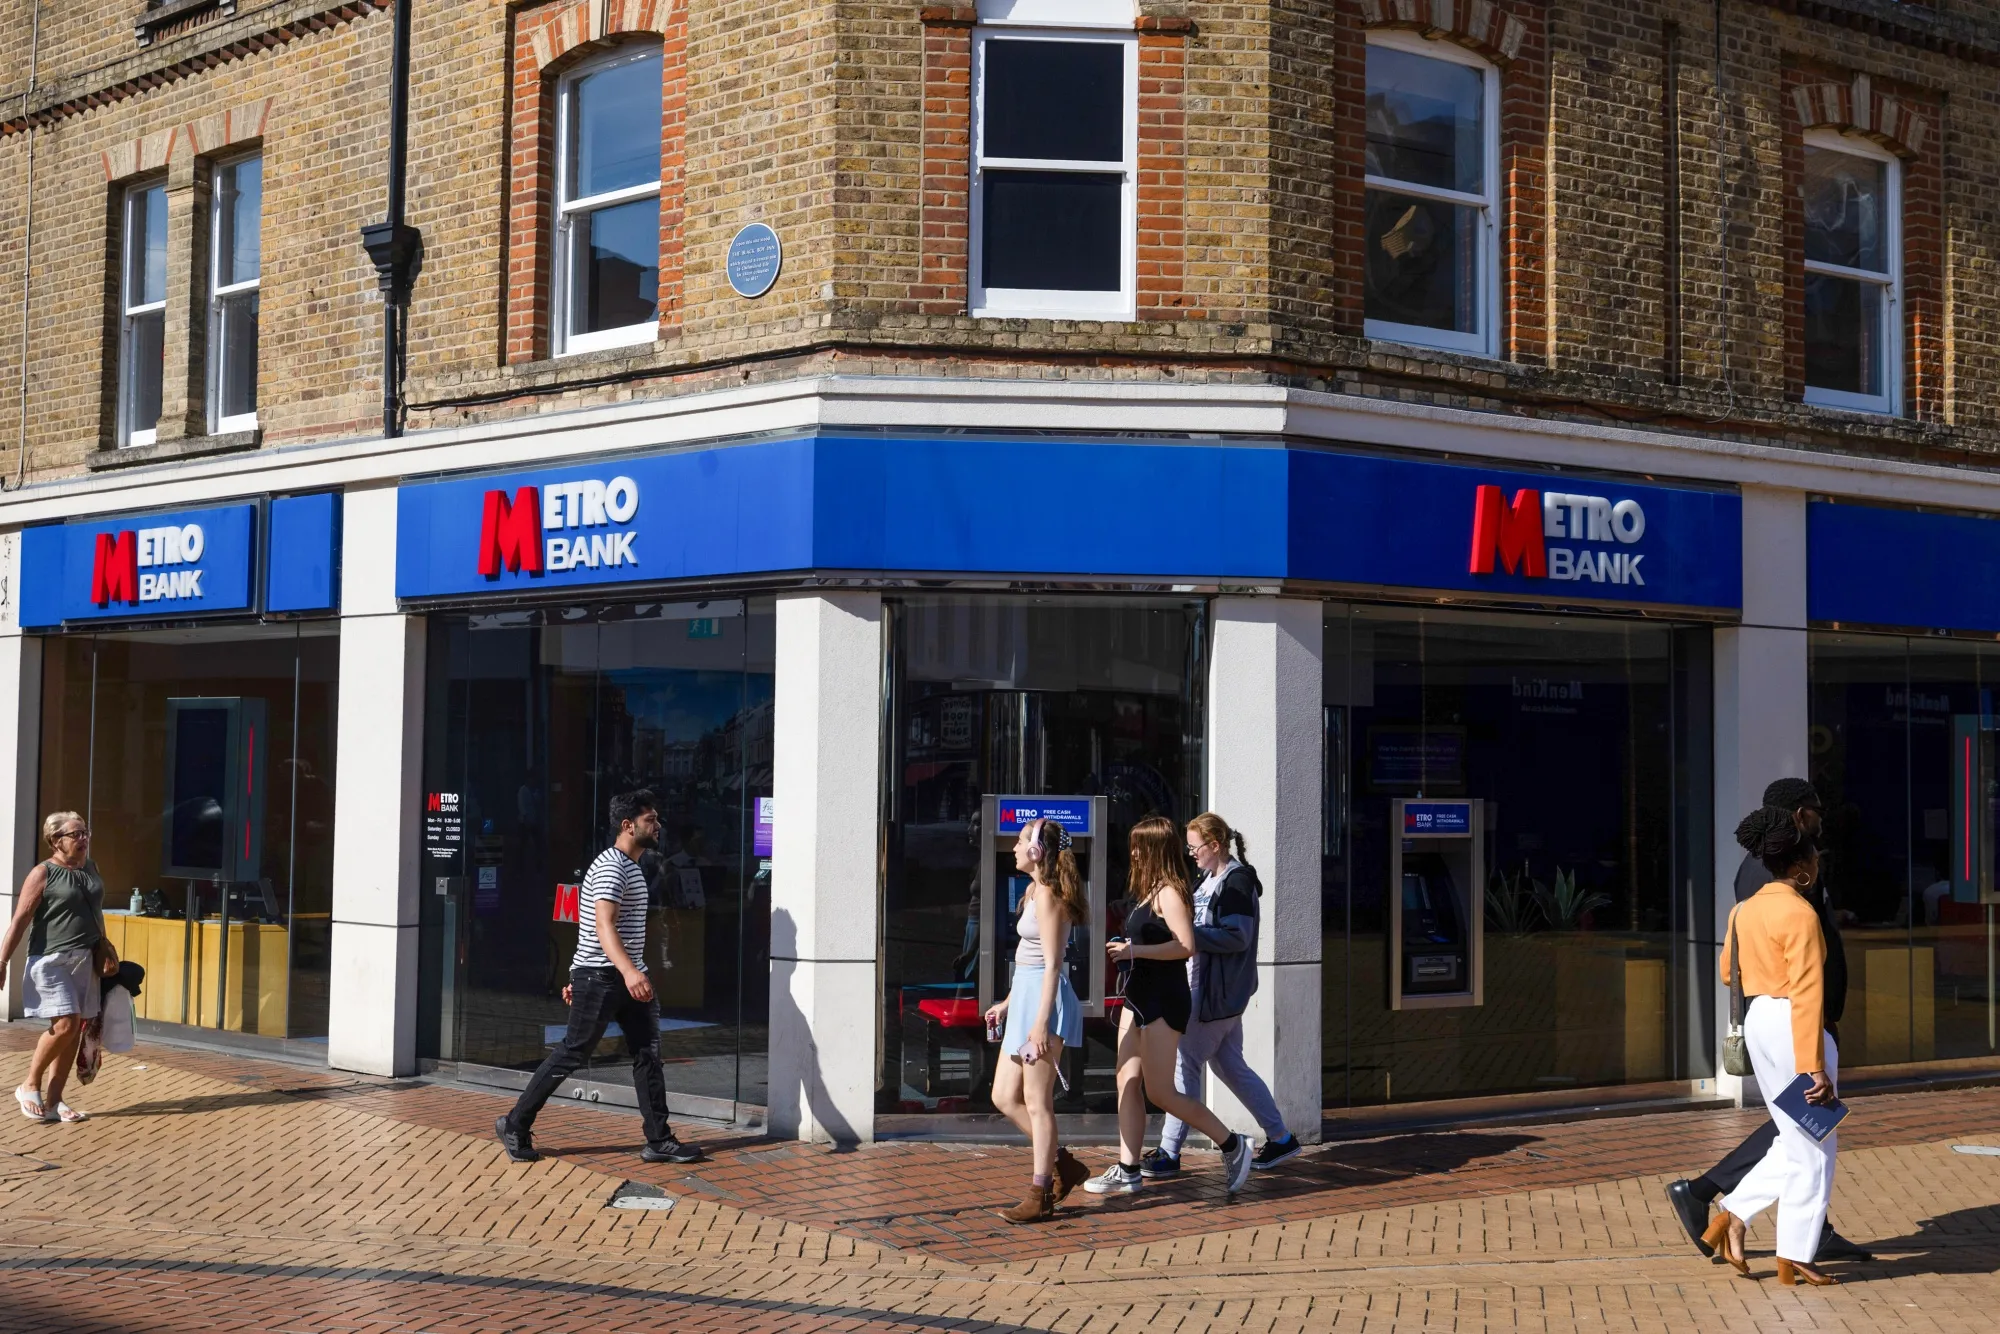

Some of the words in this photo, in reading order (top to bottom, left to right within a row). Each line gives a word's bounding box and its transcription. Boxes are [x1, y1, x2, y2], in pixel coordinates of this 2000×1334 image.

[477, 475, 639, 577] METRO
[1470, 484, 1645, 577] METRO
[90, 523, 205, 604] METRO
[546, 530, 639, 570] BANK
[1548, 546, 1645, 586] BANK
[139, 569, 203, 601] BANK
[428, 793, 458, 811] METRO
[1001, 808, 1037, 822] METRO
[1405, 813, 1432, 827] METRO
[553, 884, 579, 922] M
